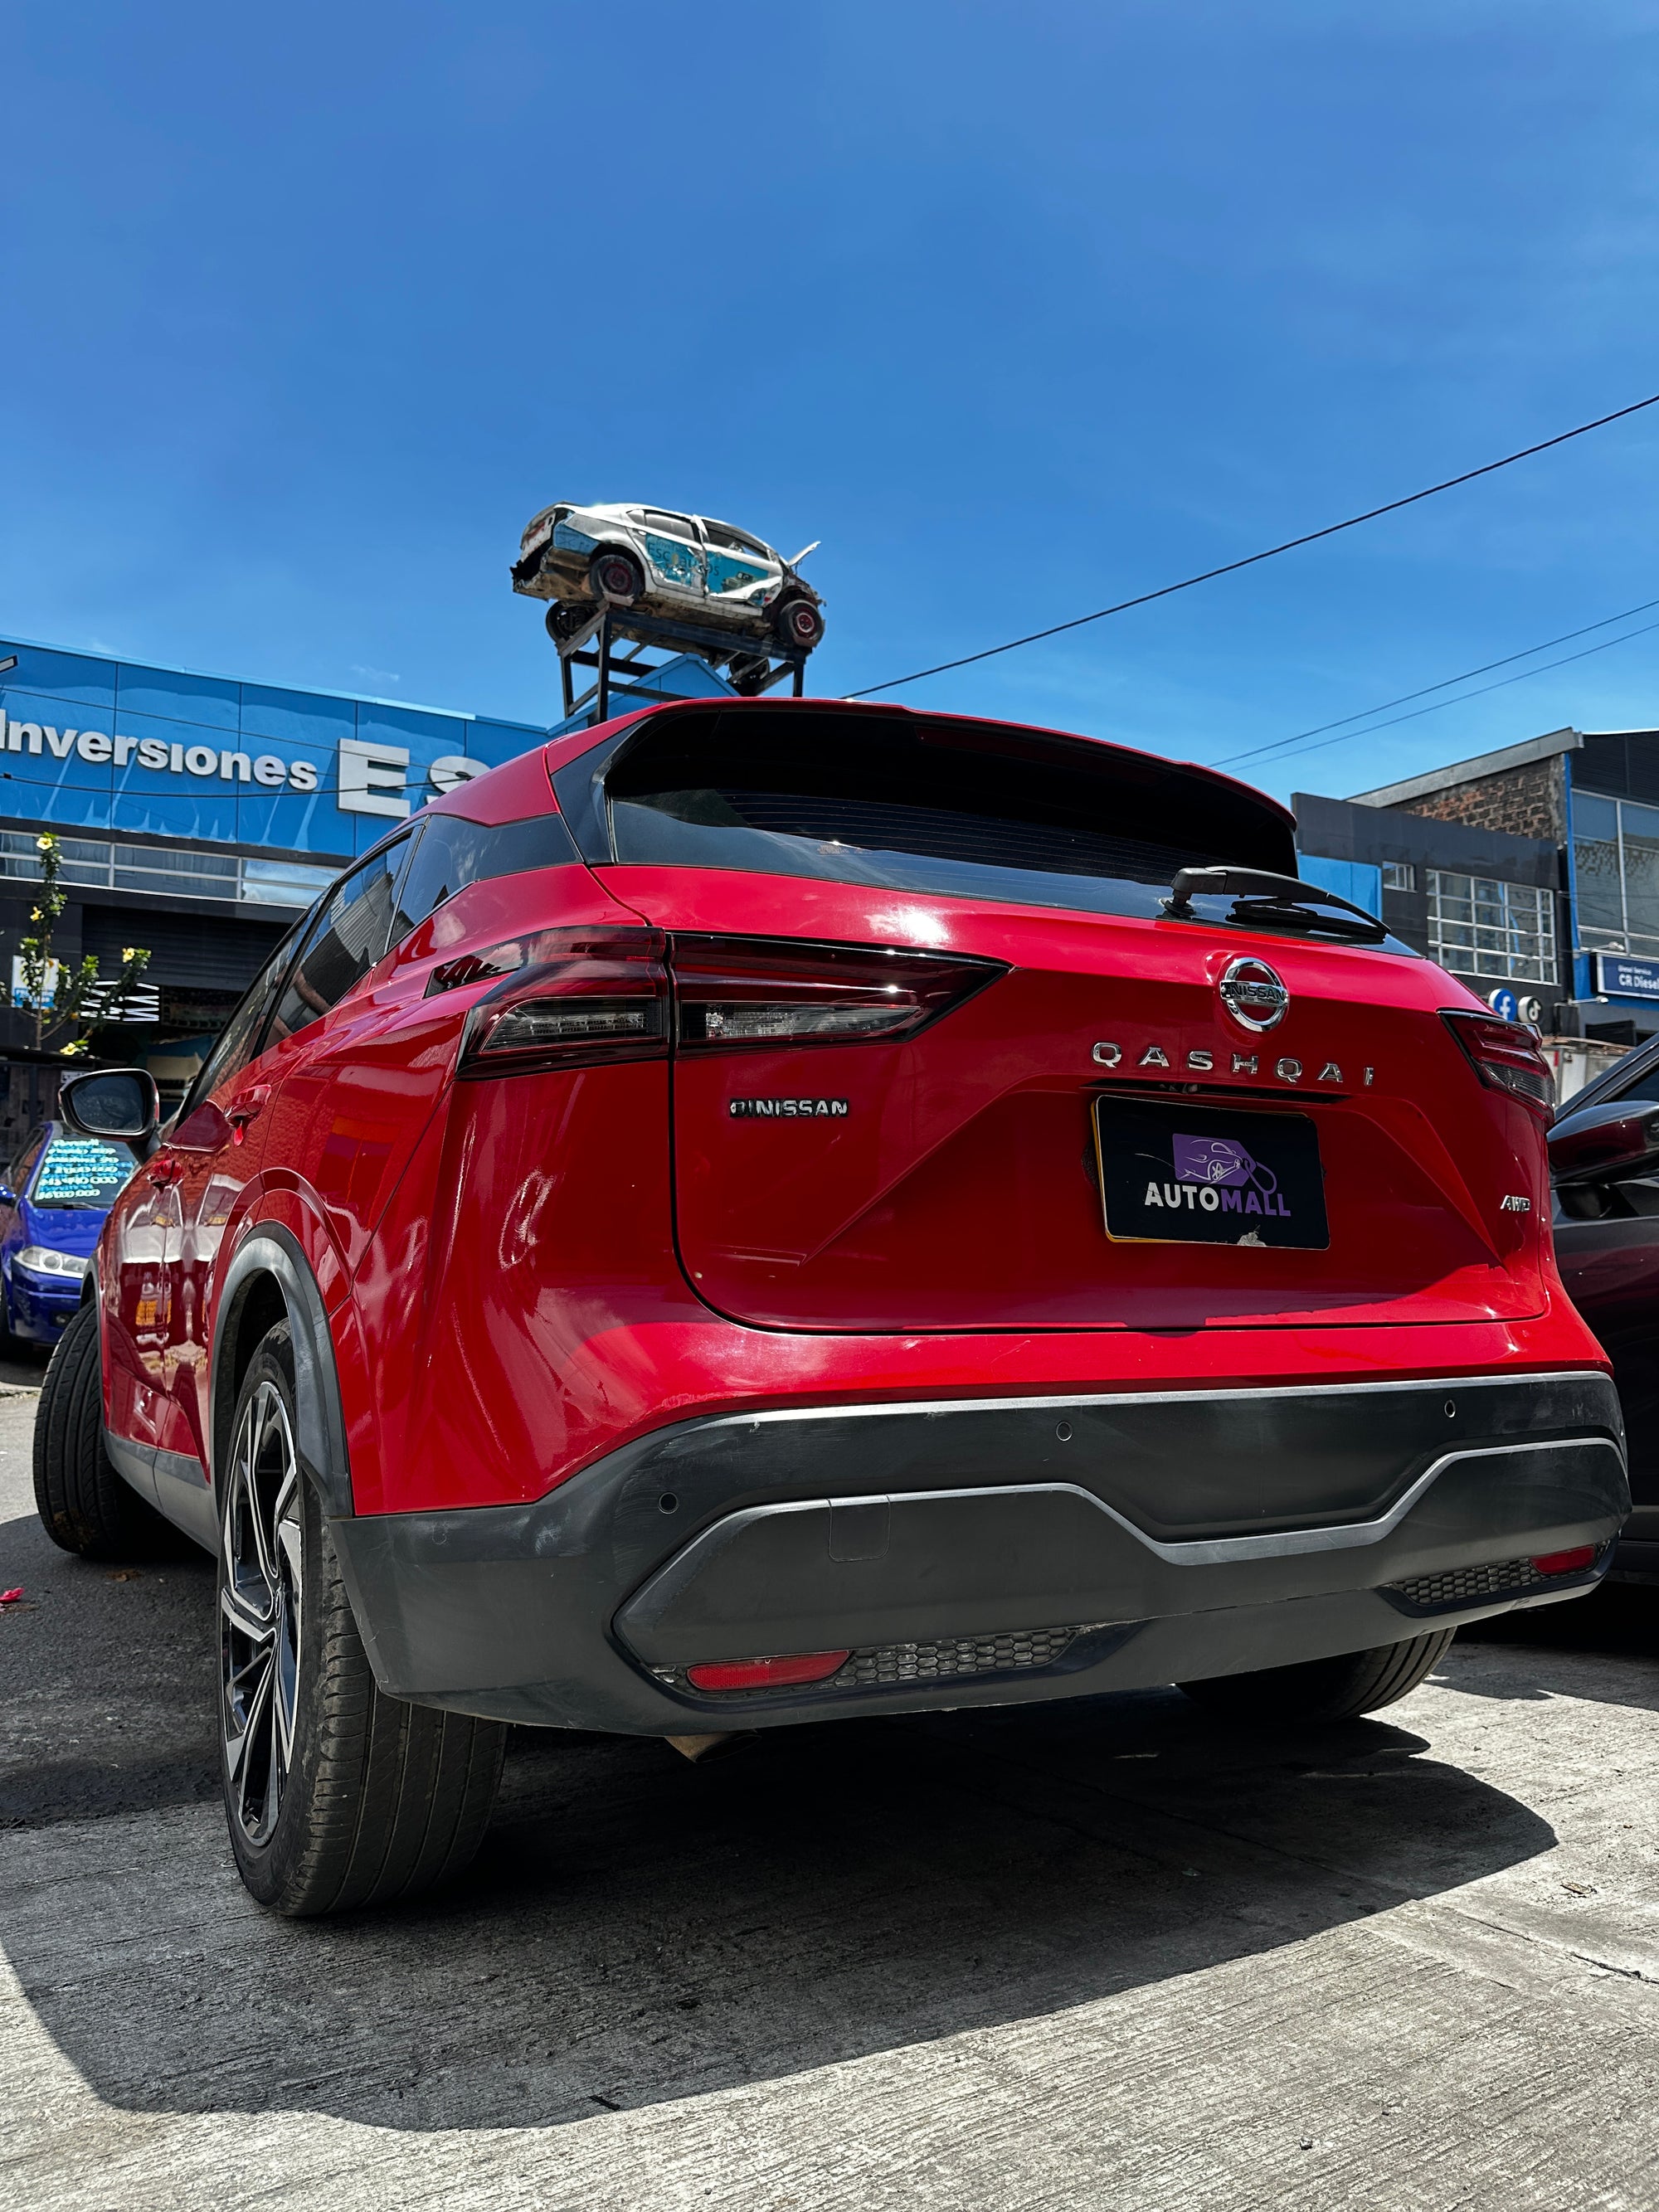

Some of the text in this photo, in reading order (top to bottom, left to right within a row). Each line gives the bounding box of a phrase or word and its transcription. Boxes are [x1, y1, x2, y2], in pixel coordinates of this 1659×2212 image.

[1231, 984, 1285, 1000] NISSAN
[1618, 973, 1633, 987] CR
[1092, 1042, 1374, 1087] QASHQAI
[1145, 1182, 1292, 1217] AUTOMALL
